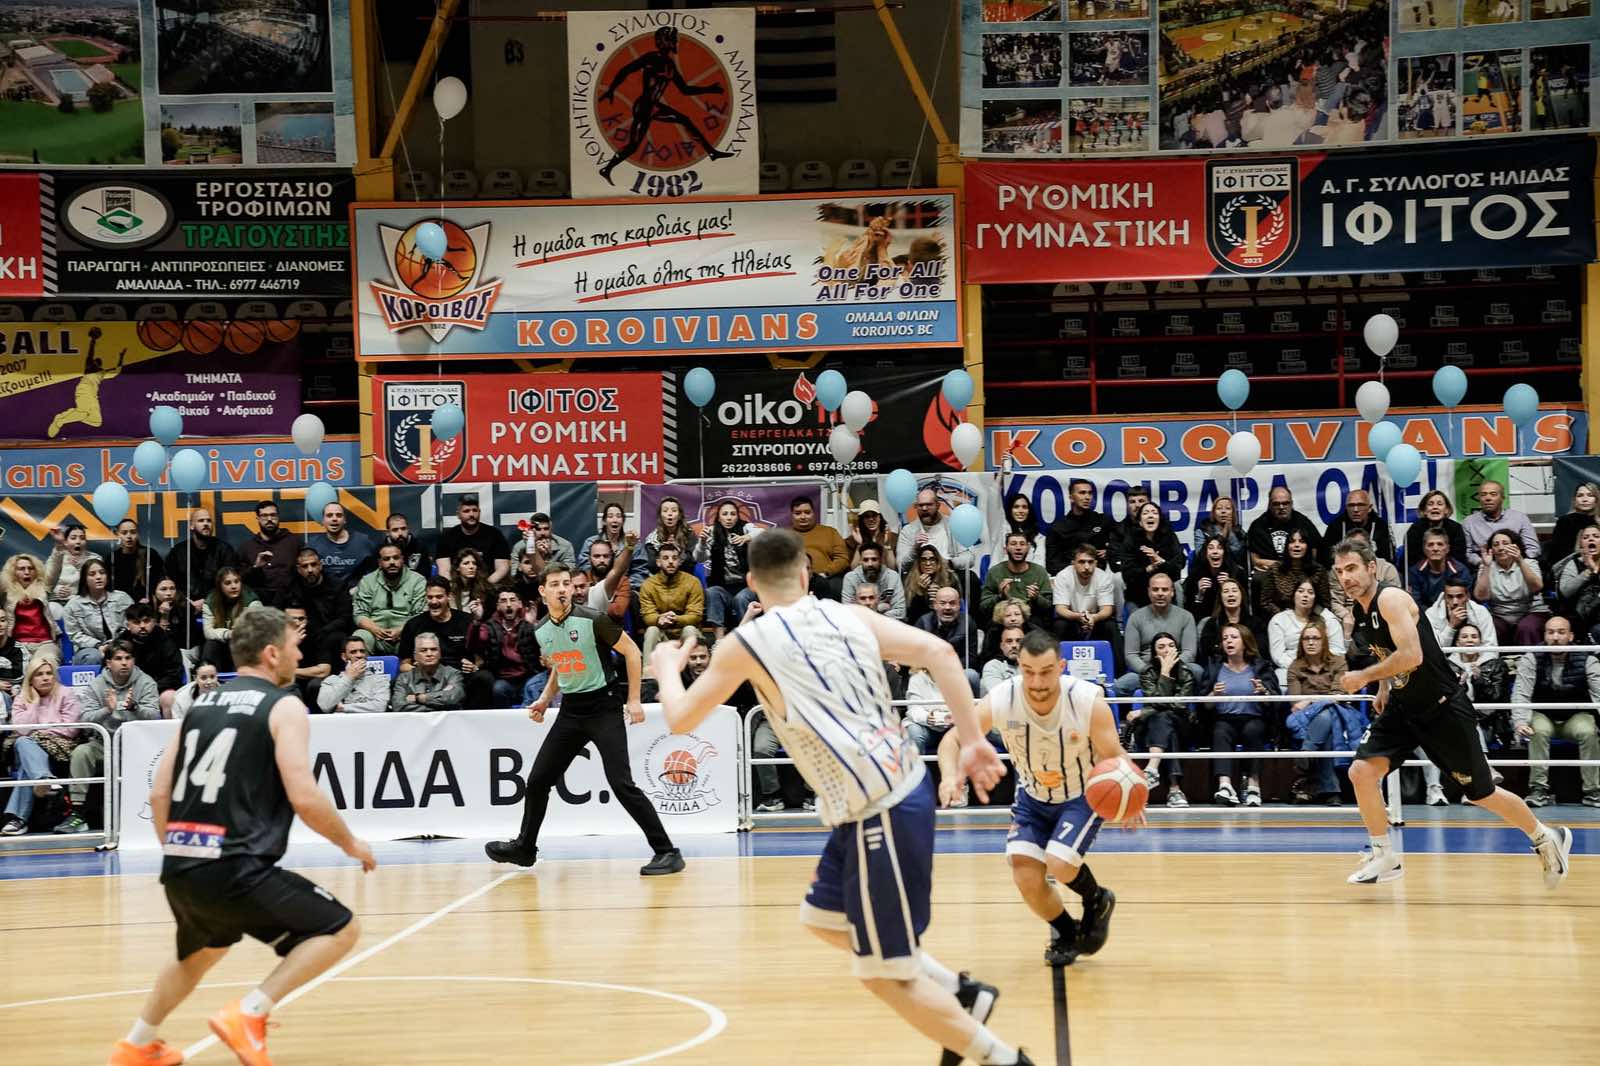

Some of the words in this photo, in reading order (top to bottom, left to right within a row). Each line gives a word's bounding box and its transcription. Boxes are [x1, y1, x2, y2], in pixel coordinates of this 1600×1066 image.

[608, 11, 711, 42] ΣΥΛΛΟΓΟΣ
[196, 182, 333, 198] ΕΡΓΟΣΤΑΣΙΟ
[630, 170, 702, 197] 1982
[1216, 174, 1288, 188] ΙΦΙΤΟΣ
[1321, 180, 1340, 194] Α.
[1346, 178, 1364, 193] Γ.
[1369, 173, 1485, 193] ΣΥΛΛΟΓΟΣ
[1490, 167, 1570, 186] ΗΛΙΔΑΣ
[999, 182, 1153, 211] ΡΥΘΜΙΚΗ
[197, 200, 331, 217] ΤΡΟΦΙΜΩΝ
[1322, 191, 1570, 247] ΙΦΙΤΟΣ
[181, 224, 349, 248] ΤΡΑΓΟΥΣΤΗΣ
[513, 235, 527, 257] Η
[533, 227, 585, 262] ομάδα
[591, 231, 619, 248] της
[624, 213, 692, 247] καρδιάς
[697, 208, 733, 240] μας!
[976, 220, 1190, 248] ΓΥΜΝΑΣΤΙΚΗ
[67, 261, 141, 272] ΠΑΡΑΓΩΓΗ
[151, 261, 266, 272] ΑΝΤΙΠΡΟΣΩΠΕΙΕΣ
[276, 260, 345, 272] ΔΙΑΝΟΜΕΣ
[575, 271, 588, 294] Η
[594, 264, 647, 299] ομάδα
[697, 263, 726, 279] της
[732, 249, 793, 276] Ηλείας
[818, 265, 859, 281] One
[865, 263, 903, 280] For
[911, 260, 942, 278] All
[116, 280, 183, 290] ΑΜΑΛΙΑΔΑ
[229, 279, 257, 290] 6977
[260, 279, 300, 290] 446719
[816, 284, 848, 301] All
[854, 284, 892, 299] For
[900, 282, 940, 298] One
[380, 291, 493, 323] ΚΟΡΟΙΒΟΣ
[845, 312, 893, 323] ΟΜΑΔΑ
[897, 310, 939, 322] ΦΙΛΩΝ
[517, 313, 819, 347] KOROIVIANS
[852, 325, 914, 337] KOROIVOS
[917, 324, 934, 336] BC
[0, 369, 53, 395] ιζουμε!!!
[185, 373, 242, 384] ΤΜΗΜΑΤΑ
[151, 391, 215, 403] Ακαδημιών
[227, 390, 276, 401] Παιδικού
[391, 394, 459, 407] ΙΦΙΤΟΣ
[508, 387, 619, 414] ΙΦΙΤΟΣ
[222, 405, 274, 418] Ανδρικού
[717, 393, 803, 426] oiko
[491, 420, 627, 444] ΡΥΘΜΙΚΗ
[731, 429, 814, 439] ΕΝΕΡΓΕΙΑΚΑ
[732, 443, 833, 456] ΣΠΥΡΟΠΟΥΛ
[0, 460, 86, 489] ans
[471, 452, 658, 476] ΓΥΜΝΑΣΤΙΚΗ
[721, 463, 791, 473] 2622038606
[1075, 648, 1092, 658] 961
[172, 727, 238, 804] 14
[313, 750, 465, 810] ΛΙΔΑ
[660, 801, 700, 812] ΗΛΙΔΑ
[1058, 821, 1074, 840] 7
